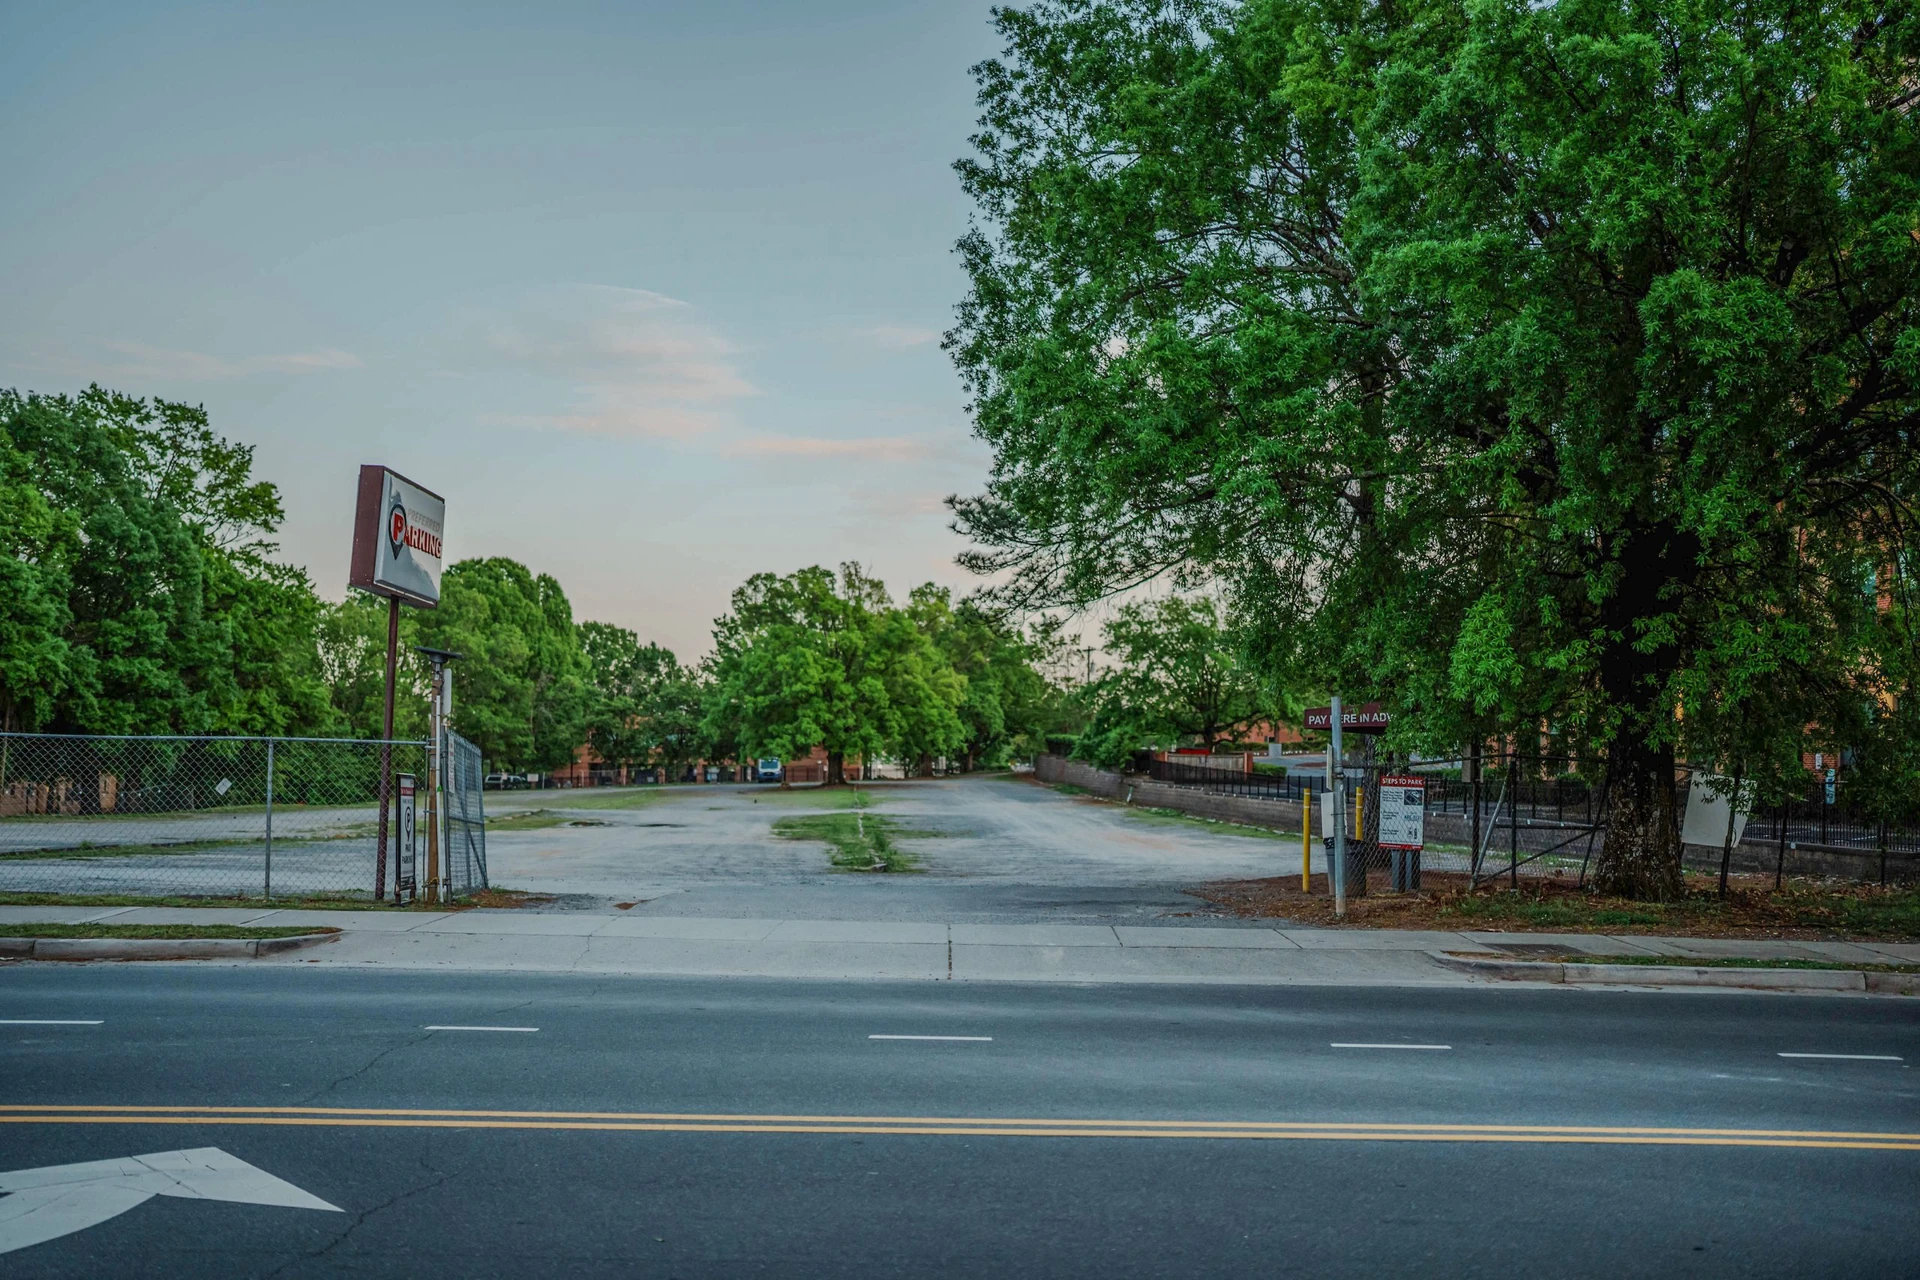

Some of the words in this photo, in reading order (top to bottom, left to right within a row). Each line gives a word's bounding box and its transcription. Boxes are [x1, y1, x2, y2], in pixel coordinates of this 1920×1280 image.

[407, 508, 440, 533] PREFERRED
[393, 511, 442, 559] PARKING
[1308, 715, 1327, 725] PAY
[1360, 713, 1370, 723] IN
